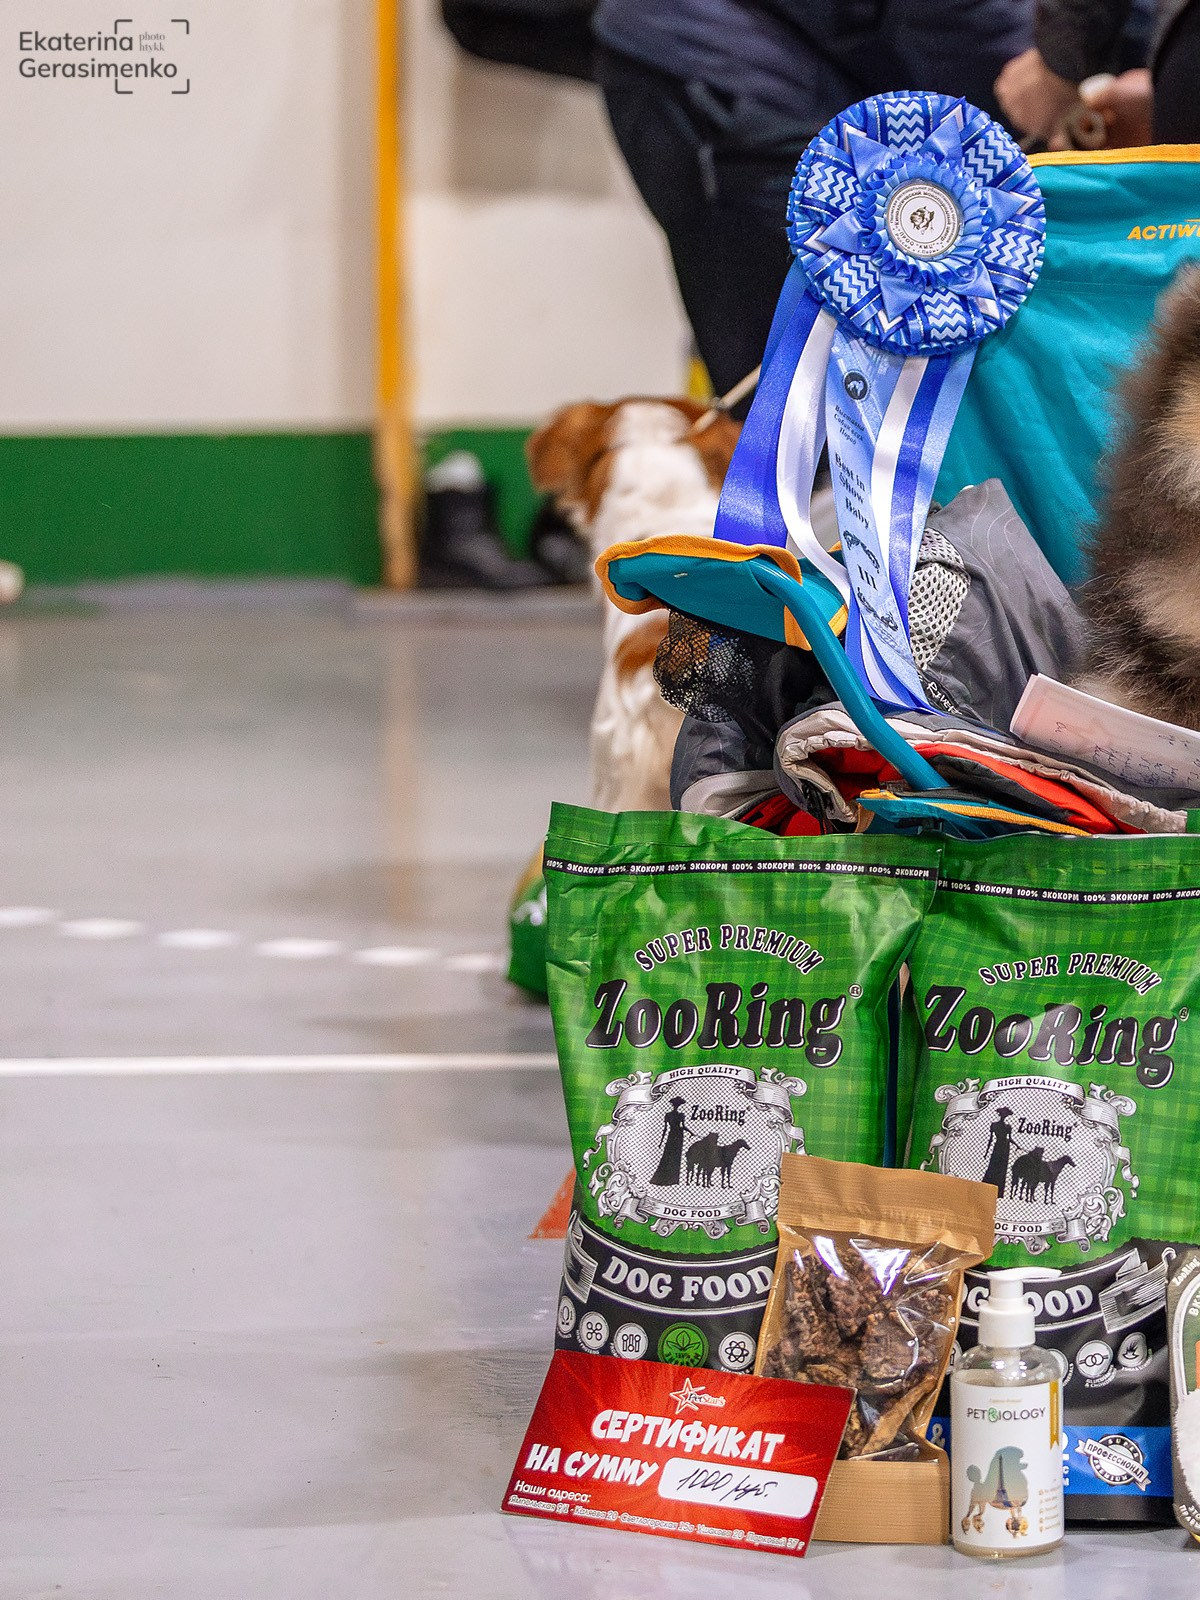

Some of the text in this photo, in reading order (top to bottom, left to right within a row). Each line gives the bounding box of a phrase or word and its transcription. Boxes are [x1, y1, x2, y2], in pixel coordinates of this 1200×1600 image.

[845, 497, 870, 529] Baby
[546, 859, 930, 879] 100% ЭКОКОРМ 100% ЭКОКОРМ 100% ЭКОКОРМ 100% ЭКОКОРМ 100% ЭКОКОРМ 100% ЭКОКОРМ
[950, 880, 972, 892] 100%
[974, 883, 1014, 896] ЭКОКОРМ
[1015, 887, 1039, 899] 100%
[1041, 890, 1080, 902] ЭКОКОРМ
[1083, 892, 1107, 902] 100%
[1110, 891, 1149, 902] ЭКОКОРМ
[1152, 890, 1174, 901] 100%
[634, 924, 825, 975] SUPER PREMIUM
[979, 952, 1163, 997] SUPER PREMIUM
[584, 978, 846, 1068] ZooRing
[924, 982, 1179, 1089] ZooRing
[669, 1066, 742, 1079] HIGH QUALITY
[997, 1078, 1071, 1091] HIGH QUALITY
[690, 1104, 746, 1126] ZooRing
[1017, 1117, 1074, 1142] ZooRing
[663, 1207, 721, 1218] DOG FOOD
[995, 1222, 1043, 1233] OG FOOD
[601, 1255, 775, 1302] DOG FOOD
[1171, 1256, 1200, 1286] ZooRing
[1023, 1284, 1094, 1318] OOD
[591, 1408, 786, 1465] СЕРТИФИКАТ
[524, 1442, 660, 1487] НА СУММУ
[1087, 1443, 1145, 1479] ПРОФЕССИОНАЛ
[514, 1479, 592, 1505] Наши адреса:
[676, 1467, 732, 1494] 1000
[508, 1495, 556, 1512] Ямпольская
